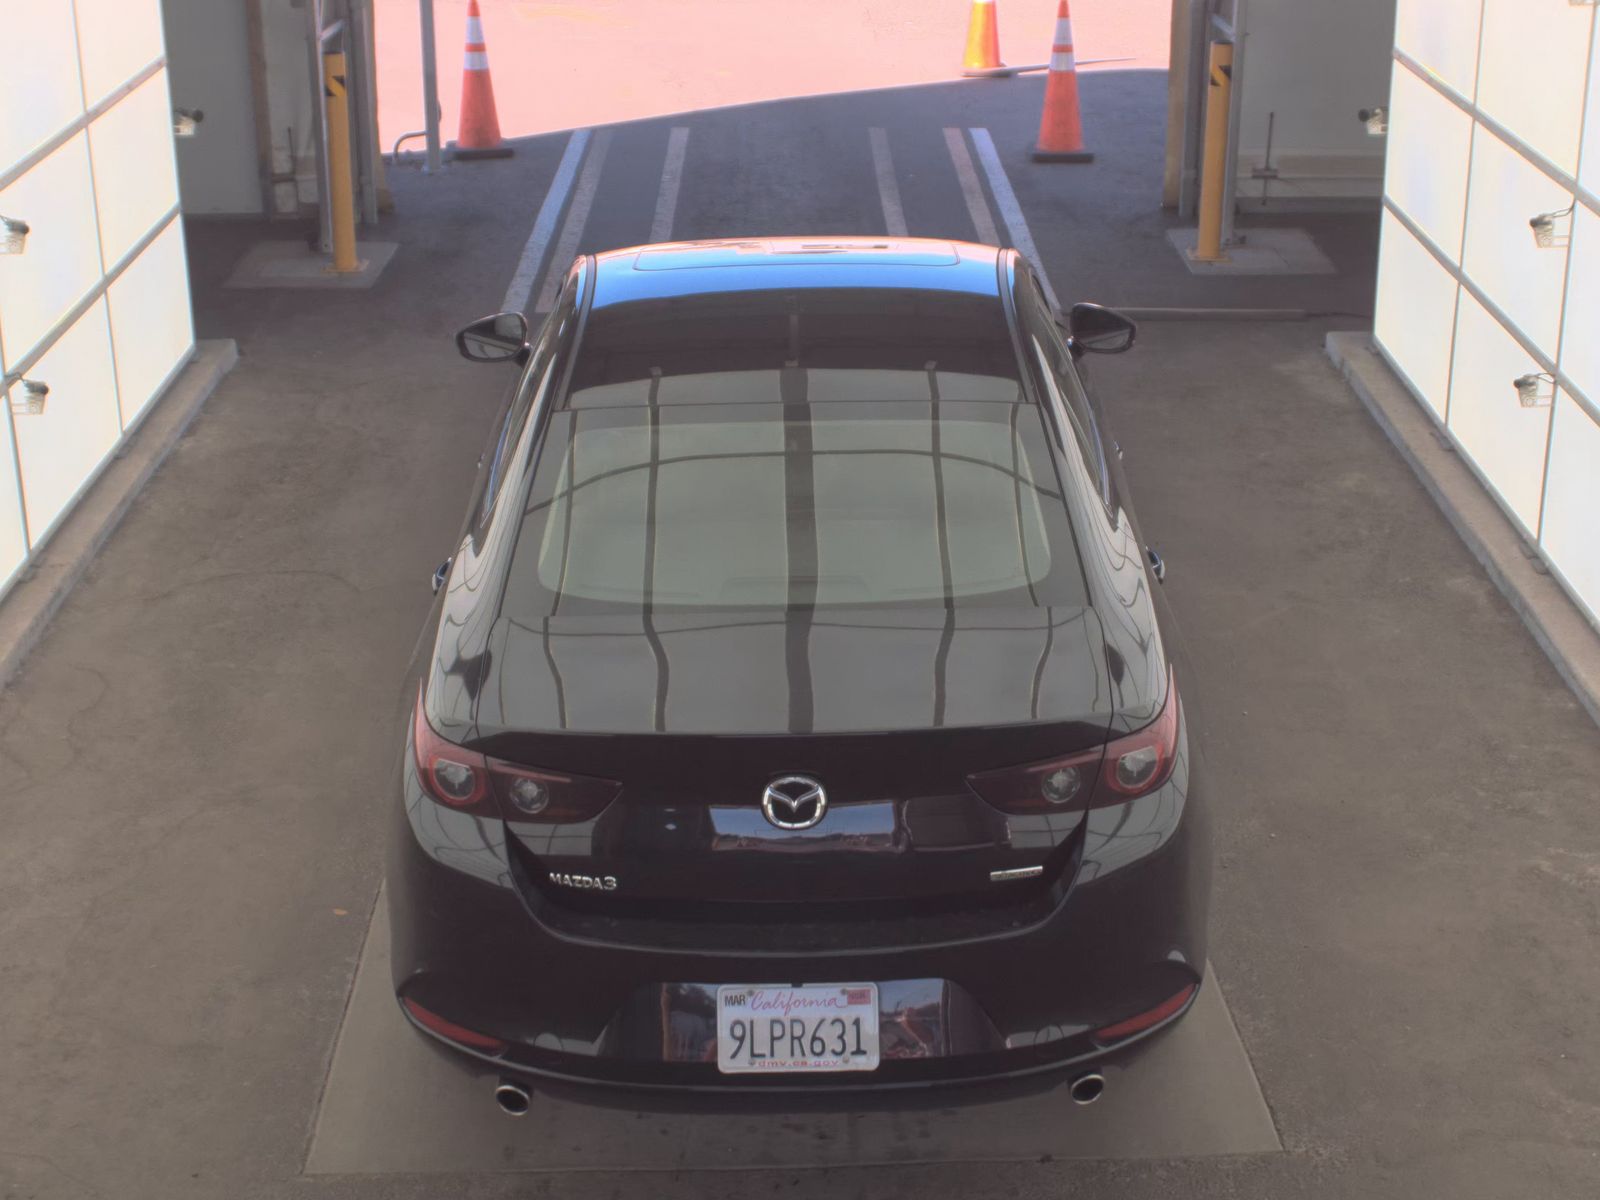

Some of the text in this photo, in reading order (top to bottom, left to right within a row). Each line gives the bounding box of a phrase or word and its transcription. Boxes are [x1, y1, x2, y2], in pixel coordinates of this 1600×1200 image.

[549, 872, 617, 890] MAZDA3
[725, 994, 746, 1007] MAR
[751, 991, 848, 1017] California
[729, 1016, 868, 1060] 9LPR631
